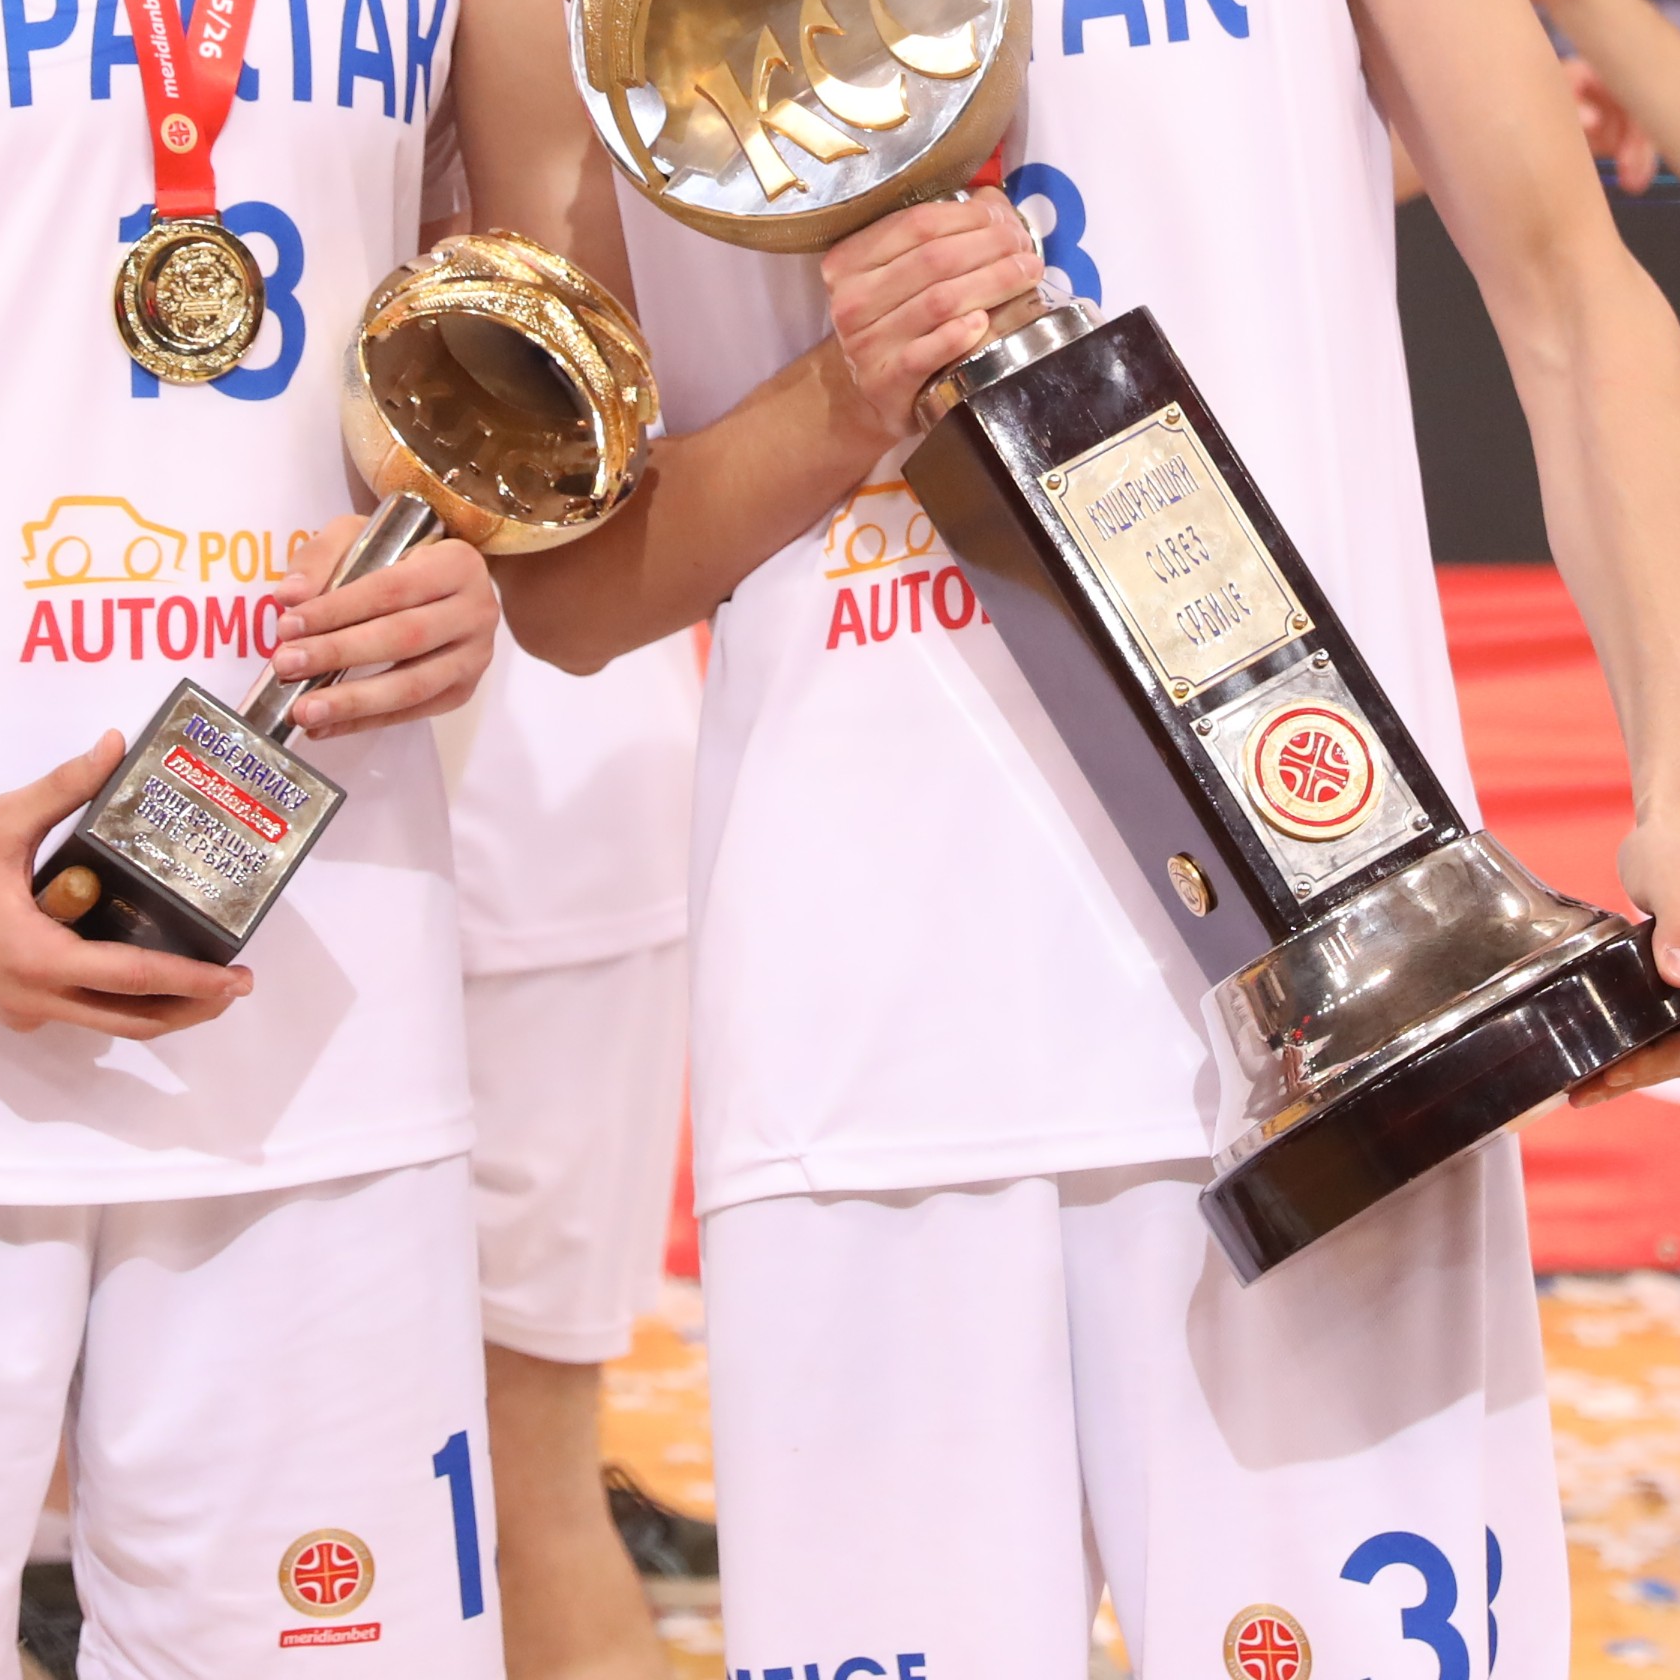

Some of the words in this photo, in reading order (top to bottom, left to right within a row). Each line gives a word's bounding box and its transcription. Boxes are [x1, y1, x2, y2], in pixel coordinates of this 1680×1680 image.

[1084, 455, 1201, 541] КОШАРКАШКИ
[1145, 525, 1210, 584] САВЕЗ
[825, 565, 992, 650] AUTO
[1176, 582, 1252, 646] СРБИЈЕ
[182, 713, 311, 812] ПОБЕДНИКУ
[142, 774, 268, 874] КОШАРКАШКЕ
[432, 1429, 485, 1620] 1
[283, 1627, 378, 1647] meridianbet
[1339, 1524, 1502, 1680] 3
